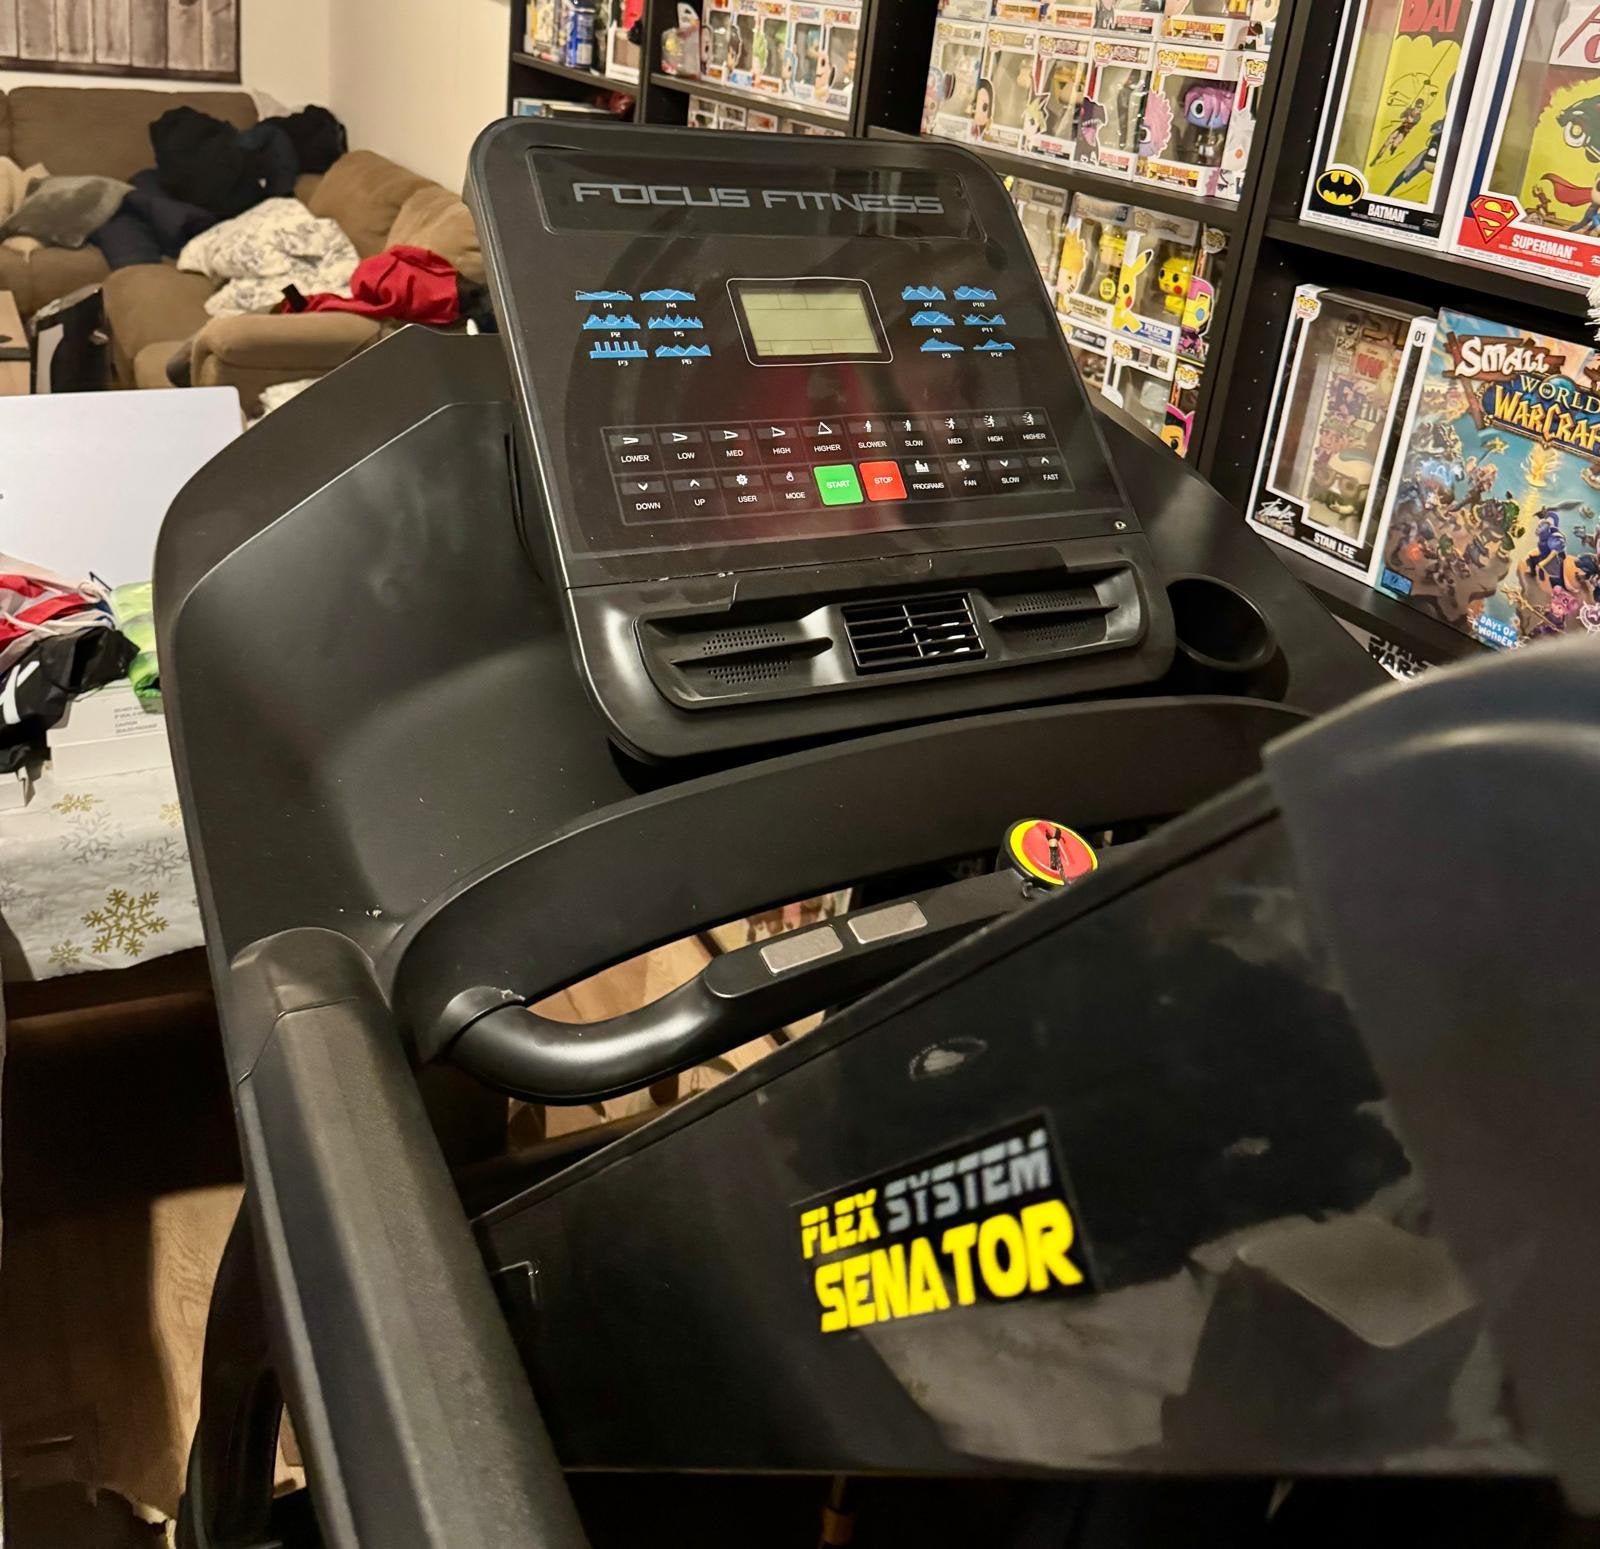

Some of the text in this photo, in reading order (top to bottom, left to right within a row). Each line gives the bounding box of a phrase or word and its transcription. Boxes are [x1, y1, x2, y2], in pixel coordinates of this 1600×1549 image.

[572, 182, 945, 214] FOCUS FITNESS
[1368, 203, 1408, 223] BATMAN
[1511, 234, 1574, 259] SUPERMAN
[1414, 330, 1426, 343] 01
[1455, 336, 1549, 377] SMALL
[1520, 375, 1600, 414] WORLD
[947, 437, 963, 445] MED
[987, 435, 1004, 443] HIGH
[1022, 433, 1046, 441] HIGHER
[814, 443, 841, 452] HIGHER
[858, 440, 887, 449] SLOWER
[905, 439, 923, 447] SLOW
[726, 449, 744, 457] MED
[772, 447, 791, 455] HIGH
[621, 454, 650, 463] LOWER
[677, 452, 695, 460] LOW
[873, 476, 894, 485] STOP
[1001, 476, 1020, 484] SLOW
[1042, 473, 1059, 481] FAST
[826, 480, 850, 489] START
[912, 482, 945, 490] PROGRAMS
[963, 479, 977, 487] FAN
[737, 495, 758, 503] USER
[785, 491, 806, 500] MODE
[635, 502, 661, 511] DOWN
[1313, 531, 1338, 551] STAN
[1337, 543, 1357, 560] LEE
[800, 1128, 1053, 1260] FLEX SYSTEM
[814, 1199, 1084, 1334] SENATOR
